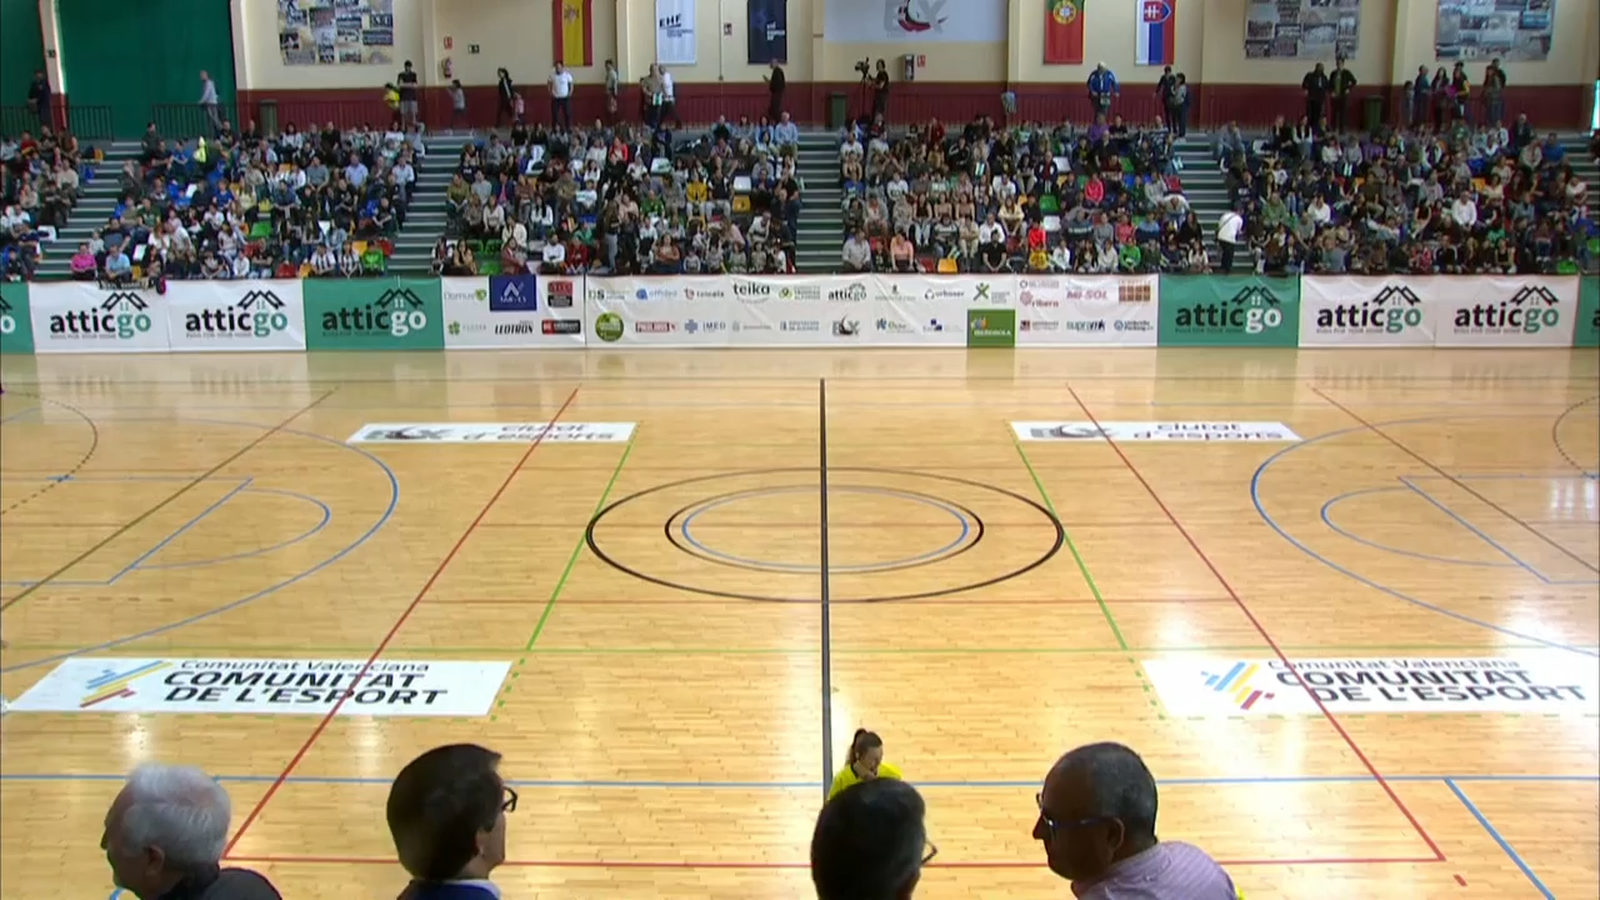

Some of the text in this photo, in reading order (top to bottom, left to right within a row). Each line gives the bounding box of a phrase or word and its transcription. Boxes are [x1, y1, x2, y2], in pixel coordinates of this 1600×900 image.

[659, 13, 682, 28] EHF
[733, 281, 770, 296] teika
[50, 307, 152, 339] atticgo
[186, 305, 289, 338] atticgo
[322, 303, 427, 337] atticgo
[1175, 301, 1283, 335] atticgo
[1316, 301, 1422, 334] atticgo
[1453, 301, 1560, 333] atticgo
[181, 660, 430, 672] Comunitat Valenciana
[1268, 658, 1520, 670] Comunitat Valenciana
[164, 670, 426, 688] COMUNITAT
[1275, 669, 1532, 686] COMUNITAT
[164, 687, 449, 704] DE L'ESPORT
[1309, 685, 1586, 702] DE L'ESPORT
